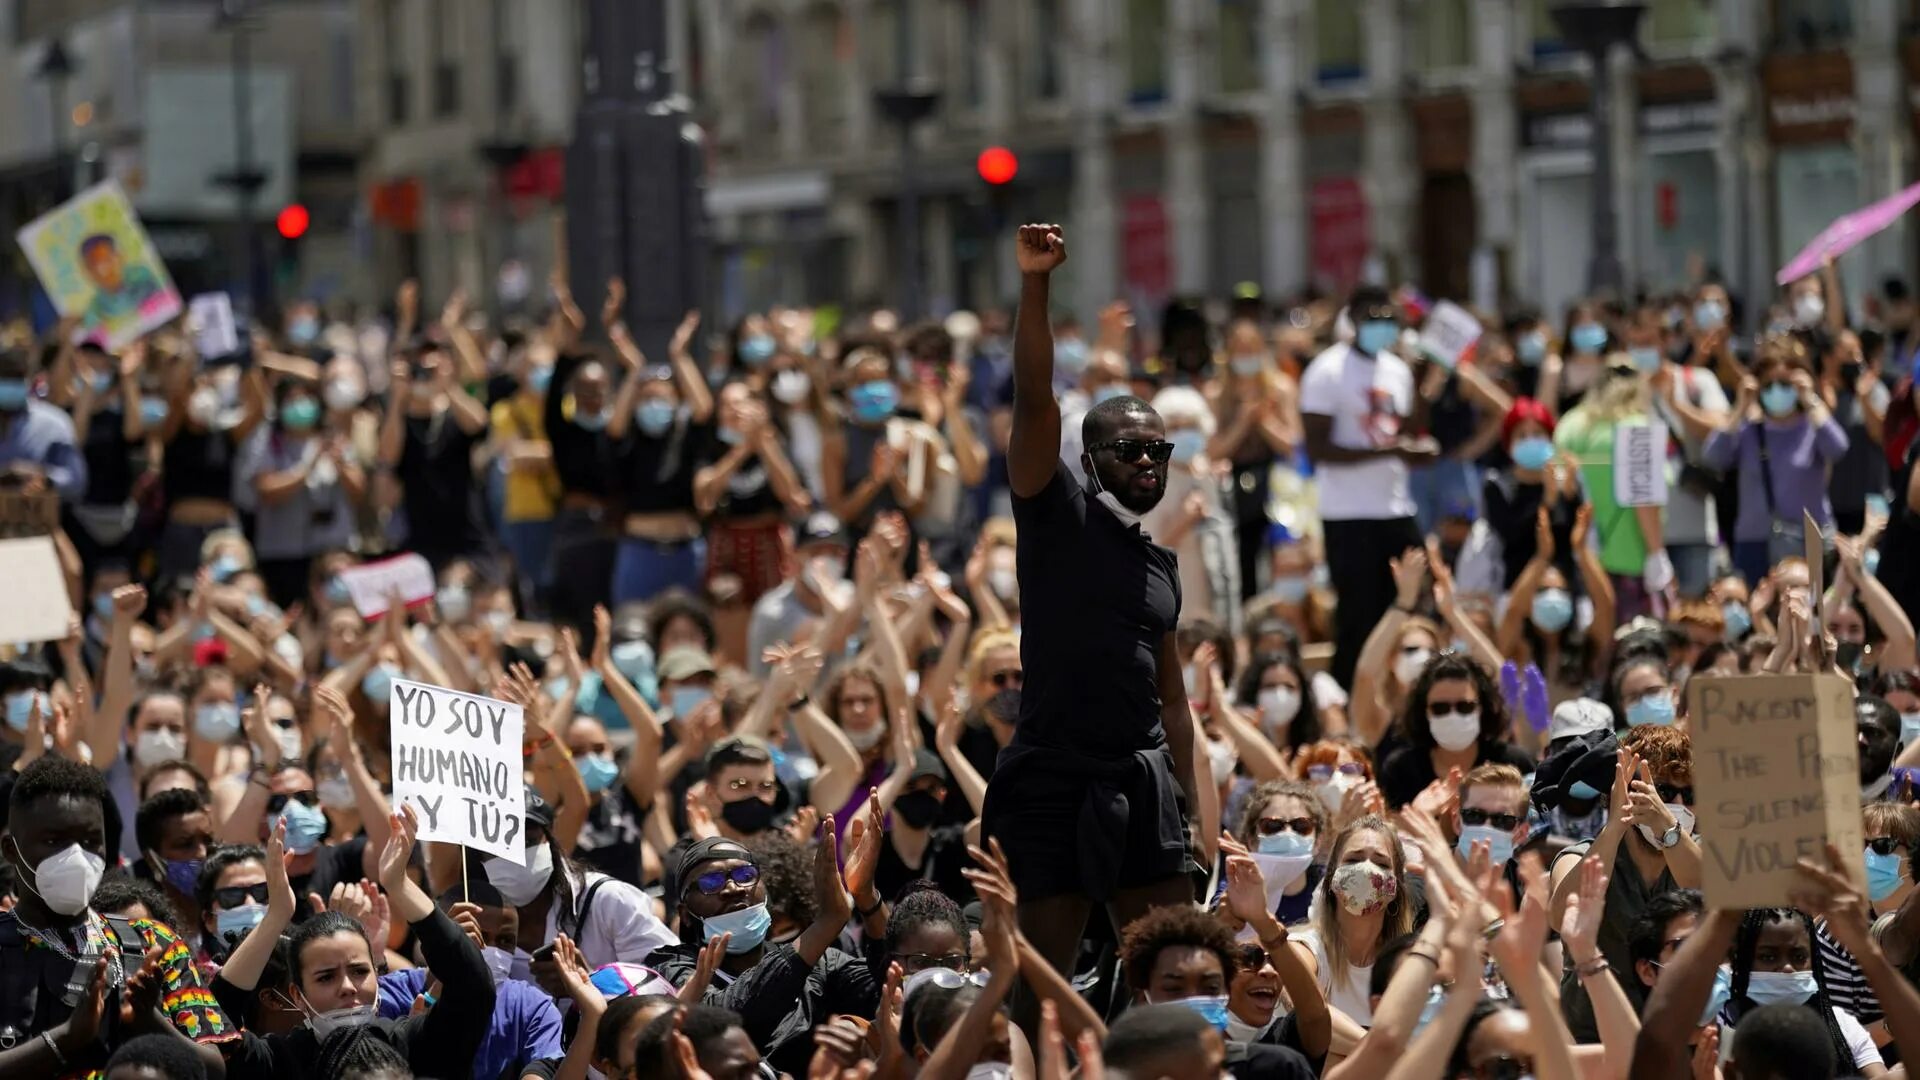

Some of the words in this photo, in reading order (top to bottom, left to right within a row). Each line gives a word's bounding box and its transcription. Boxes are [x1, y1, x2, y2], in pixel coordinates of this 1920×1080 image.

[395, 684, 436, 728] YO
[443, 697, 506, 746] SOY
[397, 743, 515, 802] HUMANO.
[461, 797, 520, 850] TÚ?
